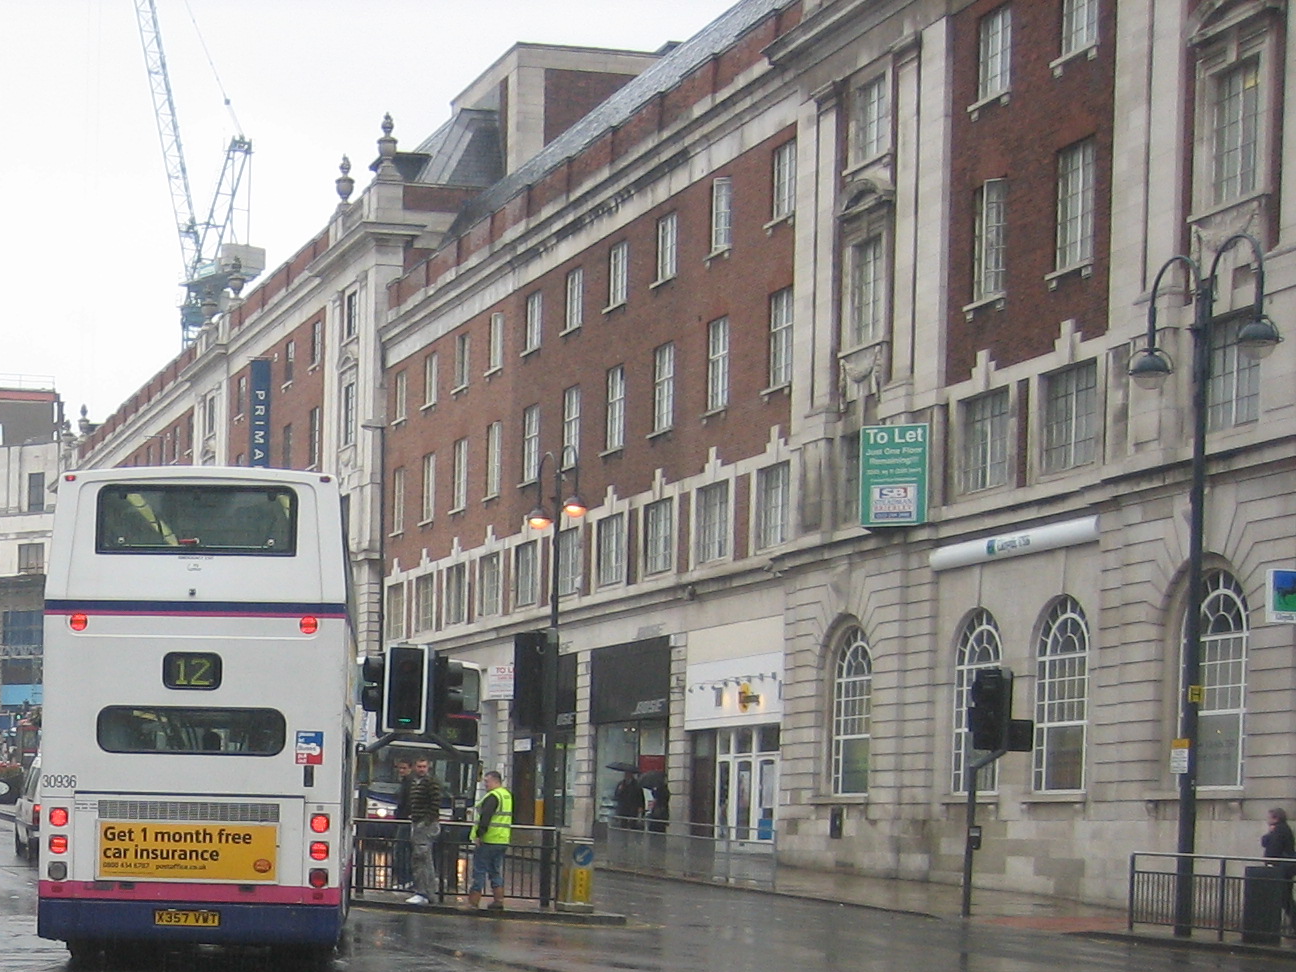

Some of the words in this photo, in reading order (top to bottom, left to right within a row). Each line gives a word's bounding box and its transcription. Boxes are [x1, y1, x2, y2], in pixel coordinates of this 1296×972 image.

[253, 390, 265, 468] PRIMA
[865, 429, 889, 444] To
[894, 427, 924, 443] Let
[175, 658, 212, 686] 12
[42, 774, 77, 789] 30936
[104, 826, 135, 842] Get
[140, 827, 147, 842] 1
[154, 828, 213, 843] month
[218, 828, 252, 844] free
[103, 846, 130, 859] car
[134, 844, 220, 861] insurance
[157, 911, 189, 923] X357
